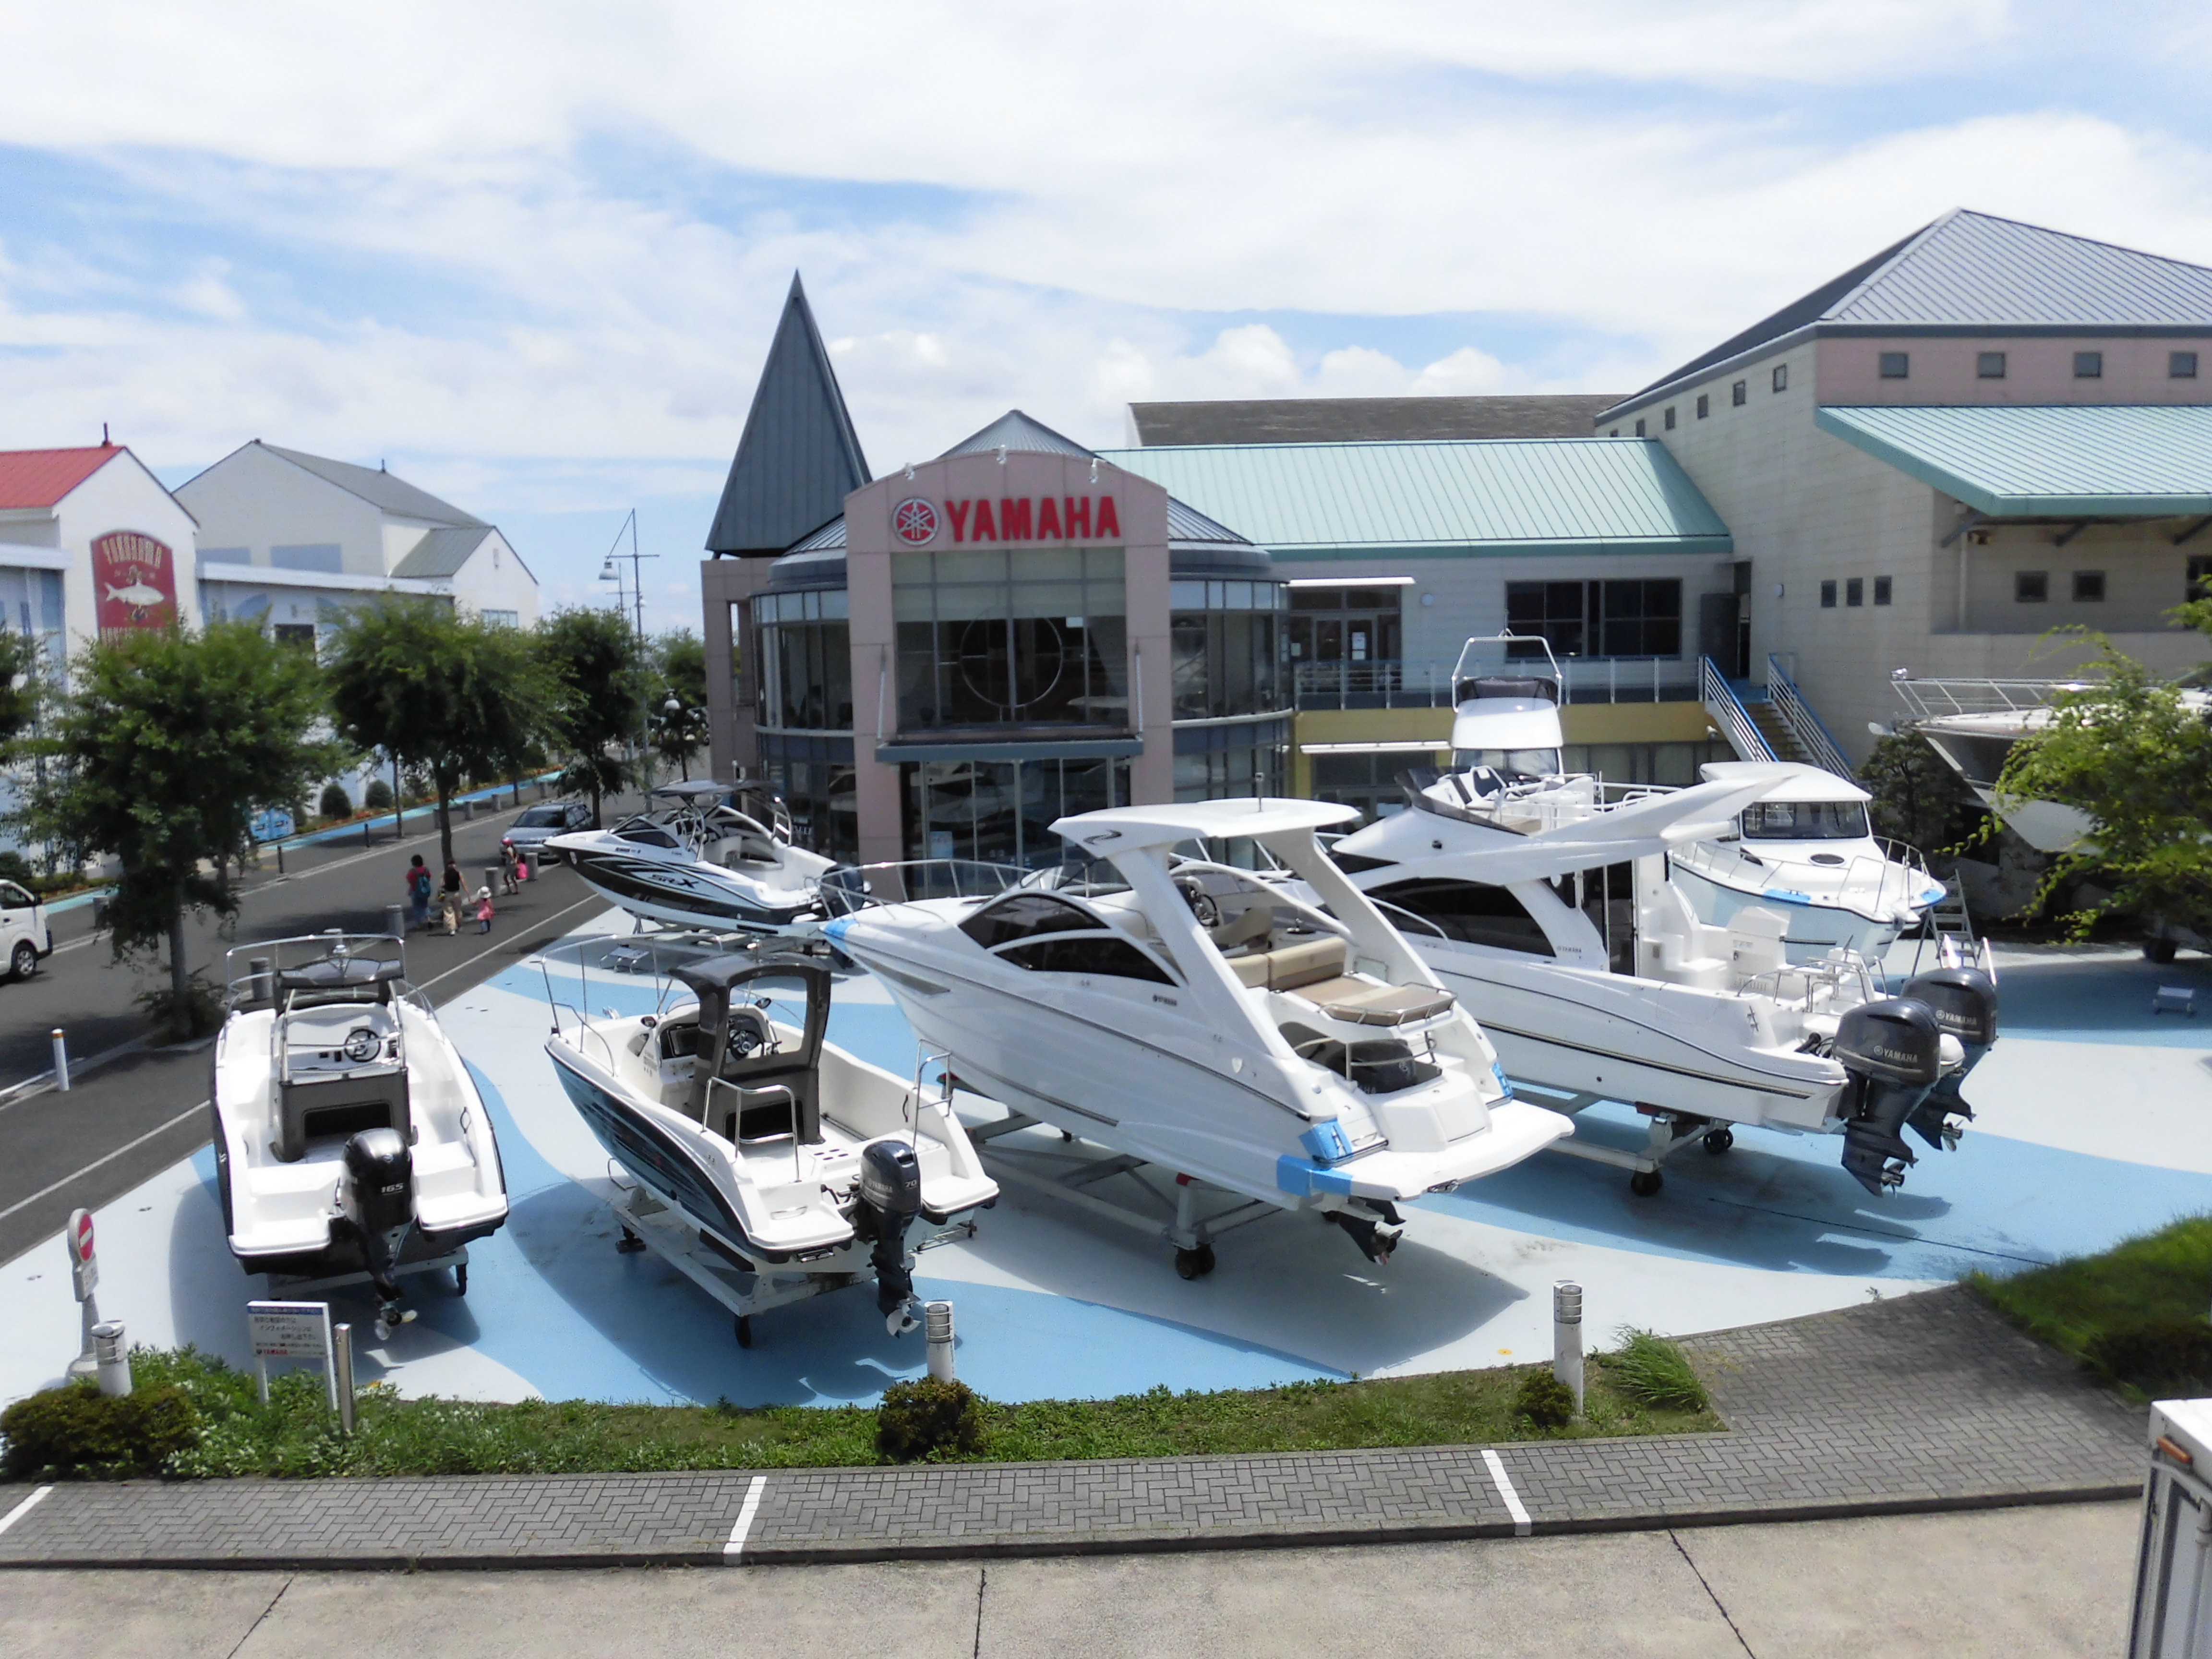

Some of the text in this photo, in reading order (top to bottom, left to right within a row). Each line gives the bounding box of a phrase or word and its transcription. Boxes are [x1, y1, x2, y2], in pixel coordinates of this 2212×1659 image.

[945, 496, 1120, 542] YAMAHA
[1946, 1012, 1977, 1026] YAMAHA
[1884, 1048, 1918, 1063] YAMAHA
[381, 1182, 404, 1193] 165
[905, 1179, 917, 1188] 70
